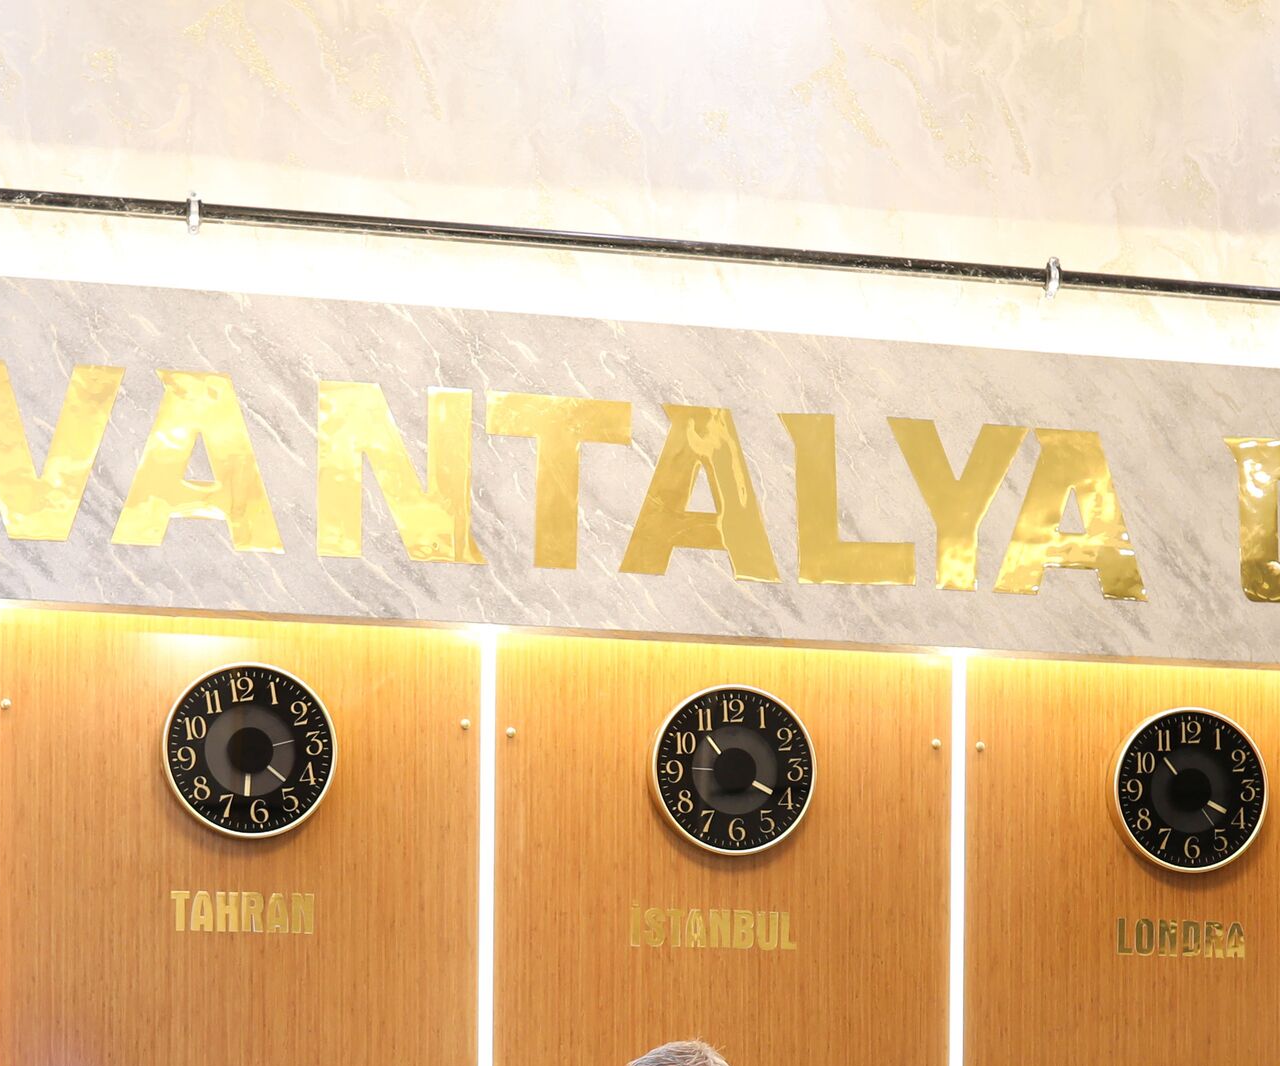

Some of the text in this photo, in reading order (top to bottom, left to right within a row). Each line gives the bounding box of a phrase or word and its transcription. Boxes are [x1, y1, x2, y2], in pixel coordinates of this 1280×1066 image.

[228, 677, 254, 702] 12
[266, 682, 279, 705] 1
[204, 690, 222, 714] 11
[290, 701, 308, 726] 2
[720, 699, 744, 723] 12
[183, 716, 206, 740] 10
[696, 708, 712, 731] 11
[758, 706, 766, 728] 1
[306, 730, 323, 756] 3
[674, 732, 696, 755] 10
[776, 728, 794, 751] 2
[1156, 729, 1171, 752] 11
[1180, 721, 1201, 744] 12
[1214, 728, 1221, 750] 1
[177, 746, 196, 770] 9
[788, 758, 803, 782] 3
[1136, 752, 1156, 774] 10
[1231, 750, 1246, 772] 2
[300, 761, 316, 786] 4
[666, 760, 683, 784] 9
[194, 776, 210, 800] 8
[282, 787, 299, 812] 5
[778, 787, 794, 810] 4
[1127, 779, 1143, 802] 9
[1240, 778, 1256, 802] 3
[219, 794, 234, 818] 7
[250, 800, 268, 824] 6
[677, 790, 694, 814] 8
[700, 810, 715, 833] 7
[728, 818, 746, 842] 6
[760, 810, 775, 834] 5
[1136, 808, 1152, 831] 8
[1231, 807, 1246, 830] 4
[1158, 828, 1172, 850] 7
[1184, 836, 1200, 859] 6
[1214, 829, 1228, 852] 5
[170, 890, 314, 934] TAHRAN
[630, 903, 797, 951] İSTANBUL
[1116, 917, 1246, 958] LONDRA
